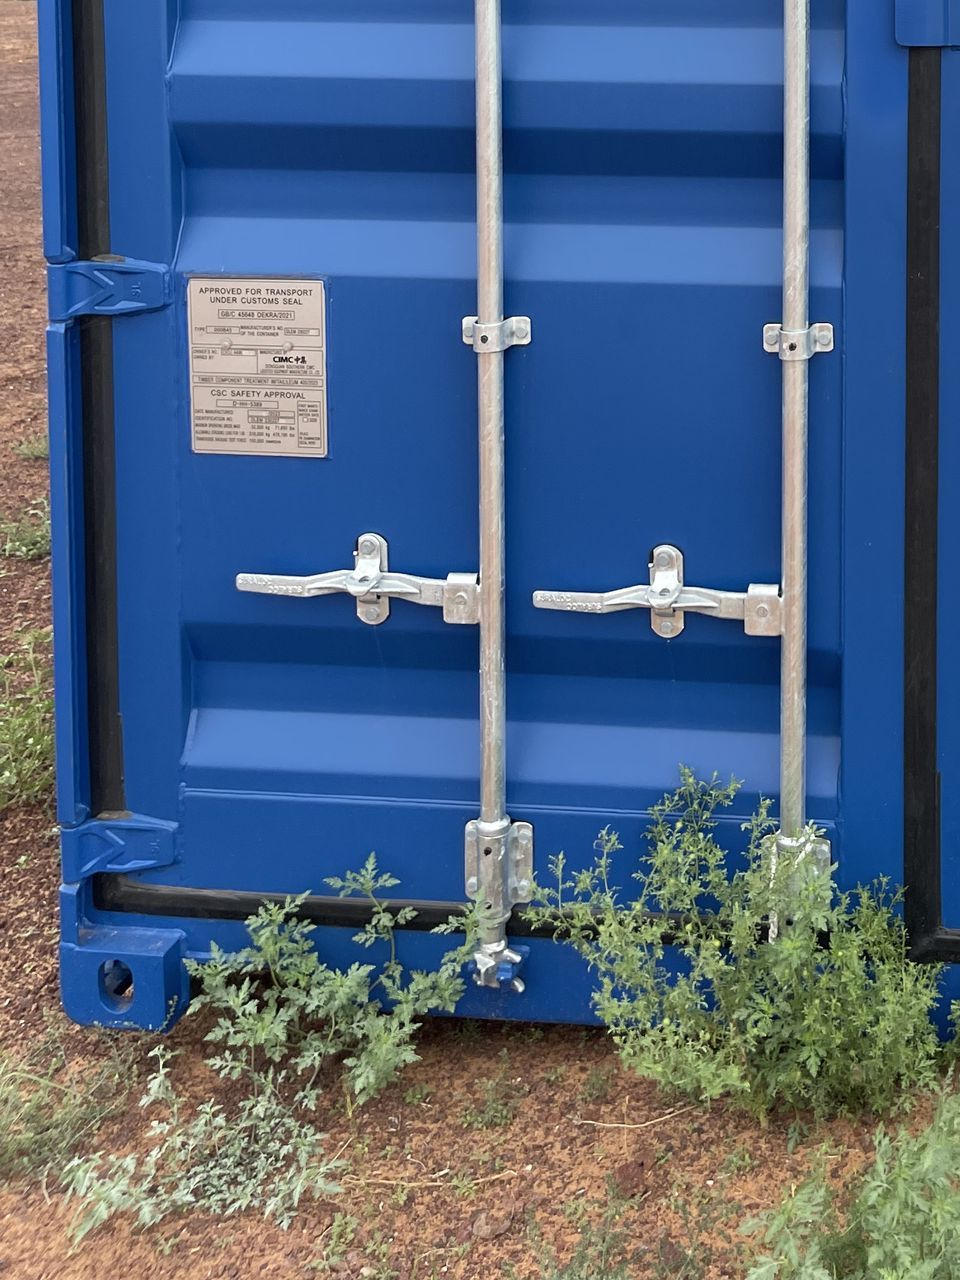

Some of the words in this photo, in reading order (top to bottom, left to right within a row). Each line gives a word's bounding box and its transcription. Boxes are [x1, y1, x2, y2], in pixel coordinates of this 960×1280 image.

[199, 287, 242, 295] APPROVED
[265, 288, 313, 297] TRANSPORT
[241, 297, 279, 305] CUSTOMS
[282, 297, 303, 305] SEAL
[272, 356, 293, 364] CIMC
[210, 389, 227, 397] CSC
[231, 390, 261, 398] SAFETY
[264, 391, 306, 399] APPROVAL
